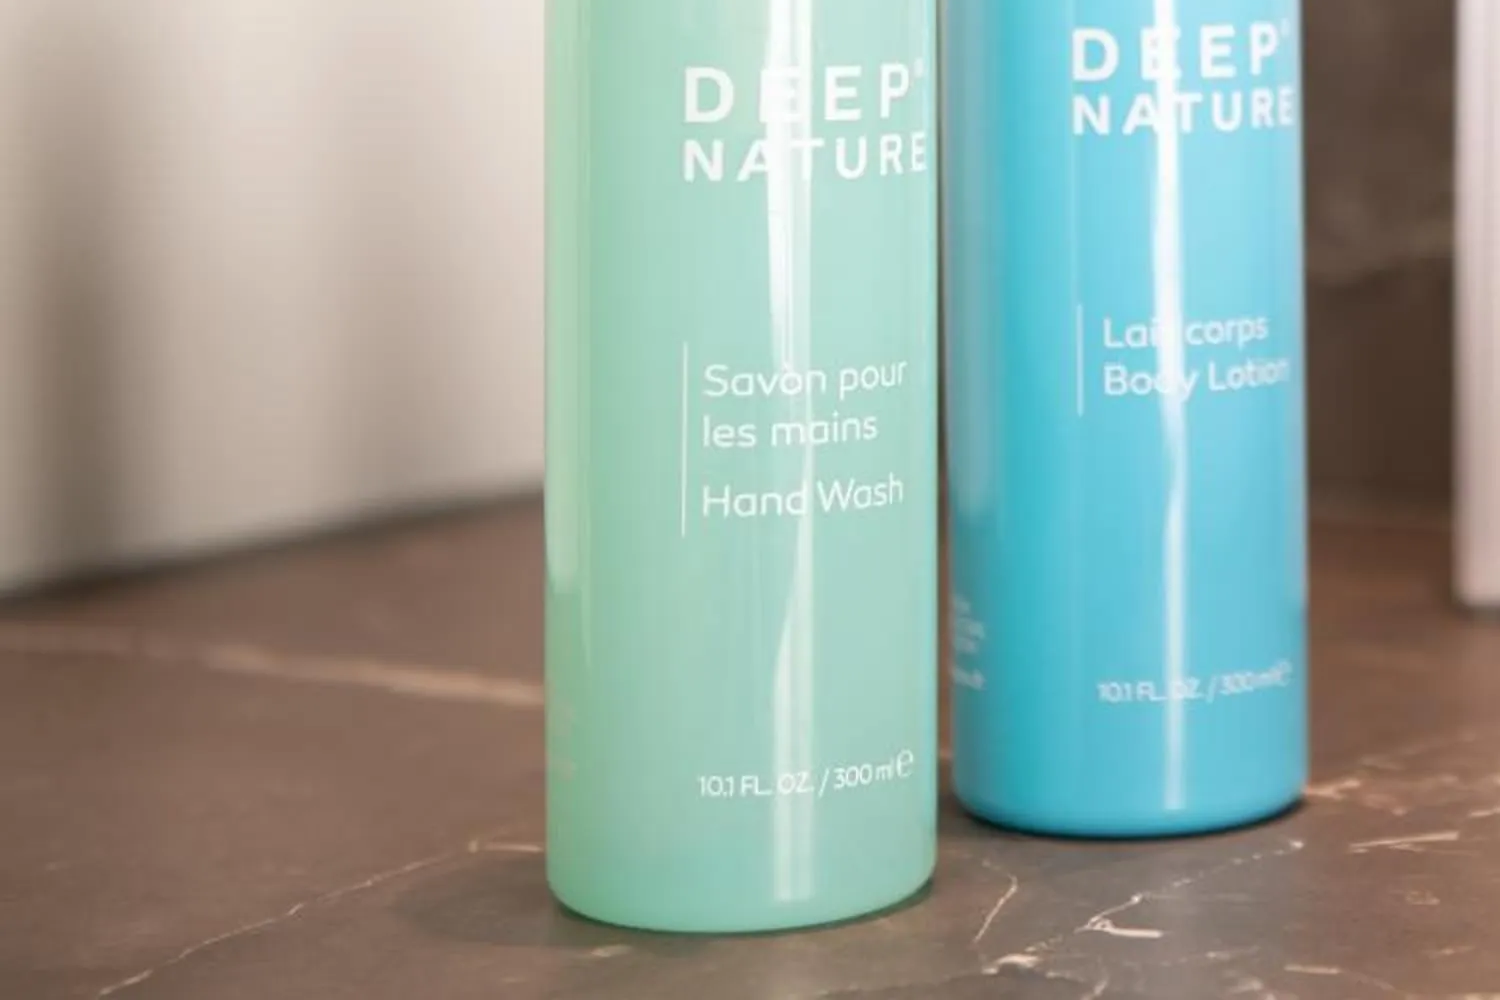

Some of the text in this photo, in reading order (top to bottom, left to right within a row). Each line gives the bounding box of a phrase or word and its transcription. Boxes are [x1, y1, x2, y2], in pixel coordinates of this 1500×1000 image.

[1072, 85, 1294, 135] NATURE
[683, 131, 928, 182] NATURE
[1103, 316, 1270, 350] Lai corps
[703, 360, 908, 401] Savon pour
[1103, 361, 1199, 403] Body
[702, 410, 880, 448] les mains
[703, 471, 905, 517] Hand Wash
